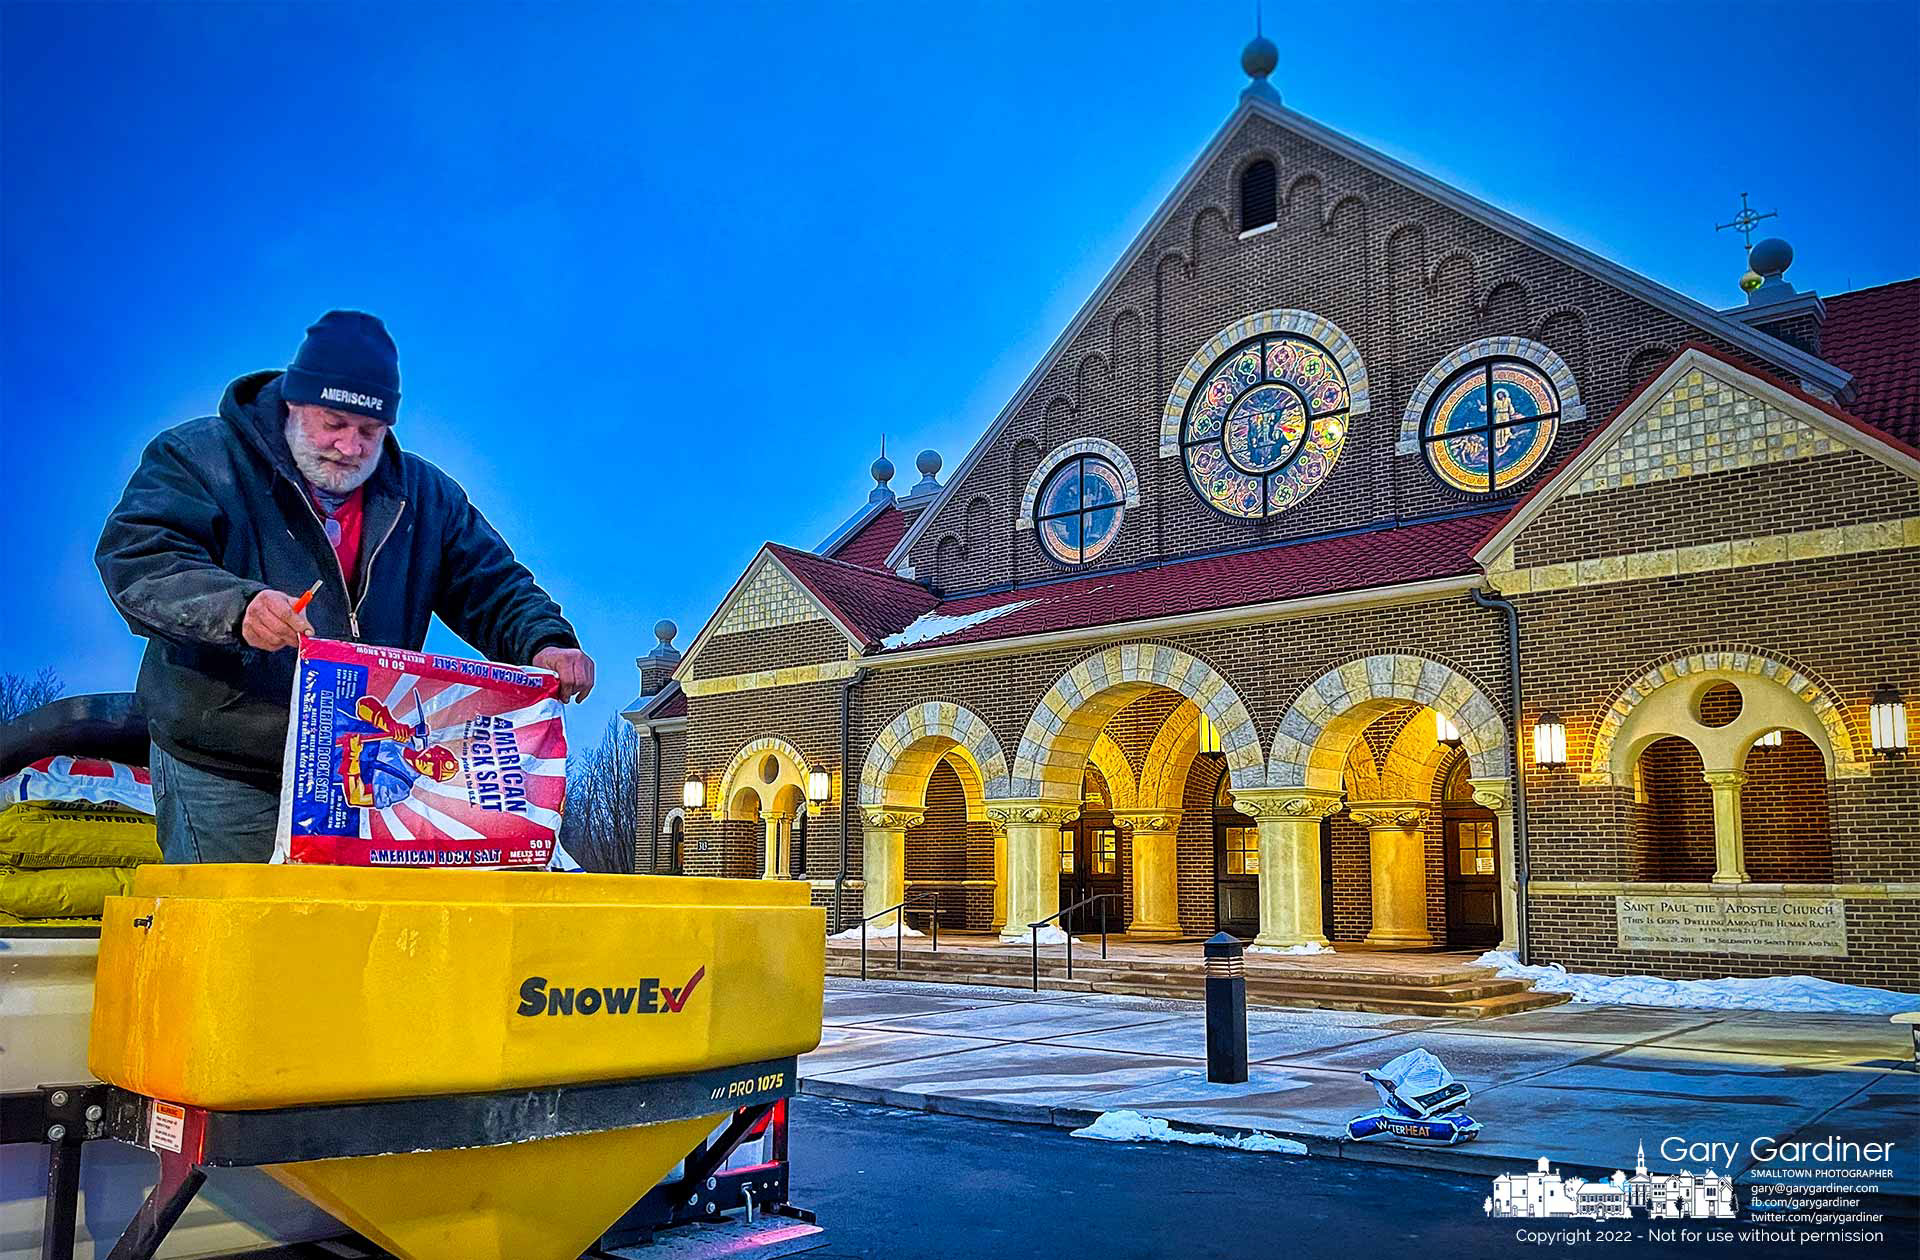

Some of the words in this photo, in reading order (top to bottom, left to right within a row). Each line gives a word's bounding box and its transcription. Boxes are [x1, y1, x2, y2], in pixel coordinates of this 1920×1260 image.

[320, 387, 383, 410] AMERISCAPE
[378, 658, 389, 668] lb
[391, 660, 405, 670] 50
[432, 657, 459, 672] SALT
[461, 662, 488, 677] ROCK
[491, 667, 543, 688] AMERICAN
[318, 690, 334, 747] AMERICAN
[471, 715, 495, 767] ROCK
[317, 747, 331, 777] ROCK
[461, 757, 470, 772] pride
[493, 716, 528, 813] AMERICAN
[315, 778, 329, 803] SALT
[476, 770, 502, 812] SALT
[84, 814, 145, 824] PATROL
[530, 839, 543, 848] 50
[370, 850, 436, 865] AMERICAN
[438, 850, 474, 865] ROCK
[474, 849, 502, 864] SALT
[510, 850, 533, 858] MELTS
[1623, 901, 1655, 912] SAINT
[1661, 902, 1689, 913] PAUL
[1694, 904, 1715, 913] THE
[1726, 903, 1777, 914] APOSTLE
[1783, 903, 1833, 915] CHURCH
[1684, 917, 1724, 926] DWELLING
[1727, 919, 1757, 927] AMONG
[1757, 919, 1774, 927] THE
[1777, 920, 1808, 928] HUMAN
[727, 1078, 755, 1099] PRO
[757, 1072, 785, 1093] 1075
[1375, 1120, 1431, 1136] WTERHEAT
